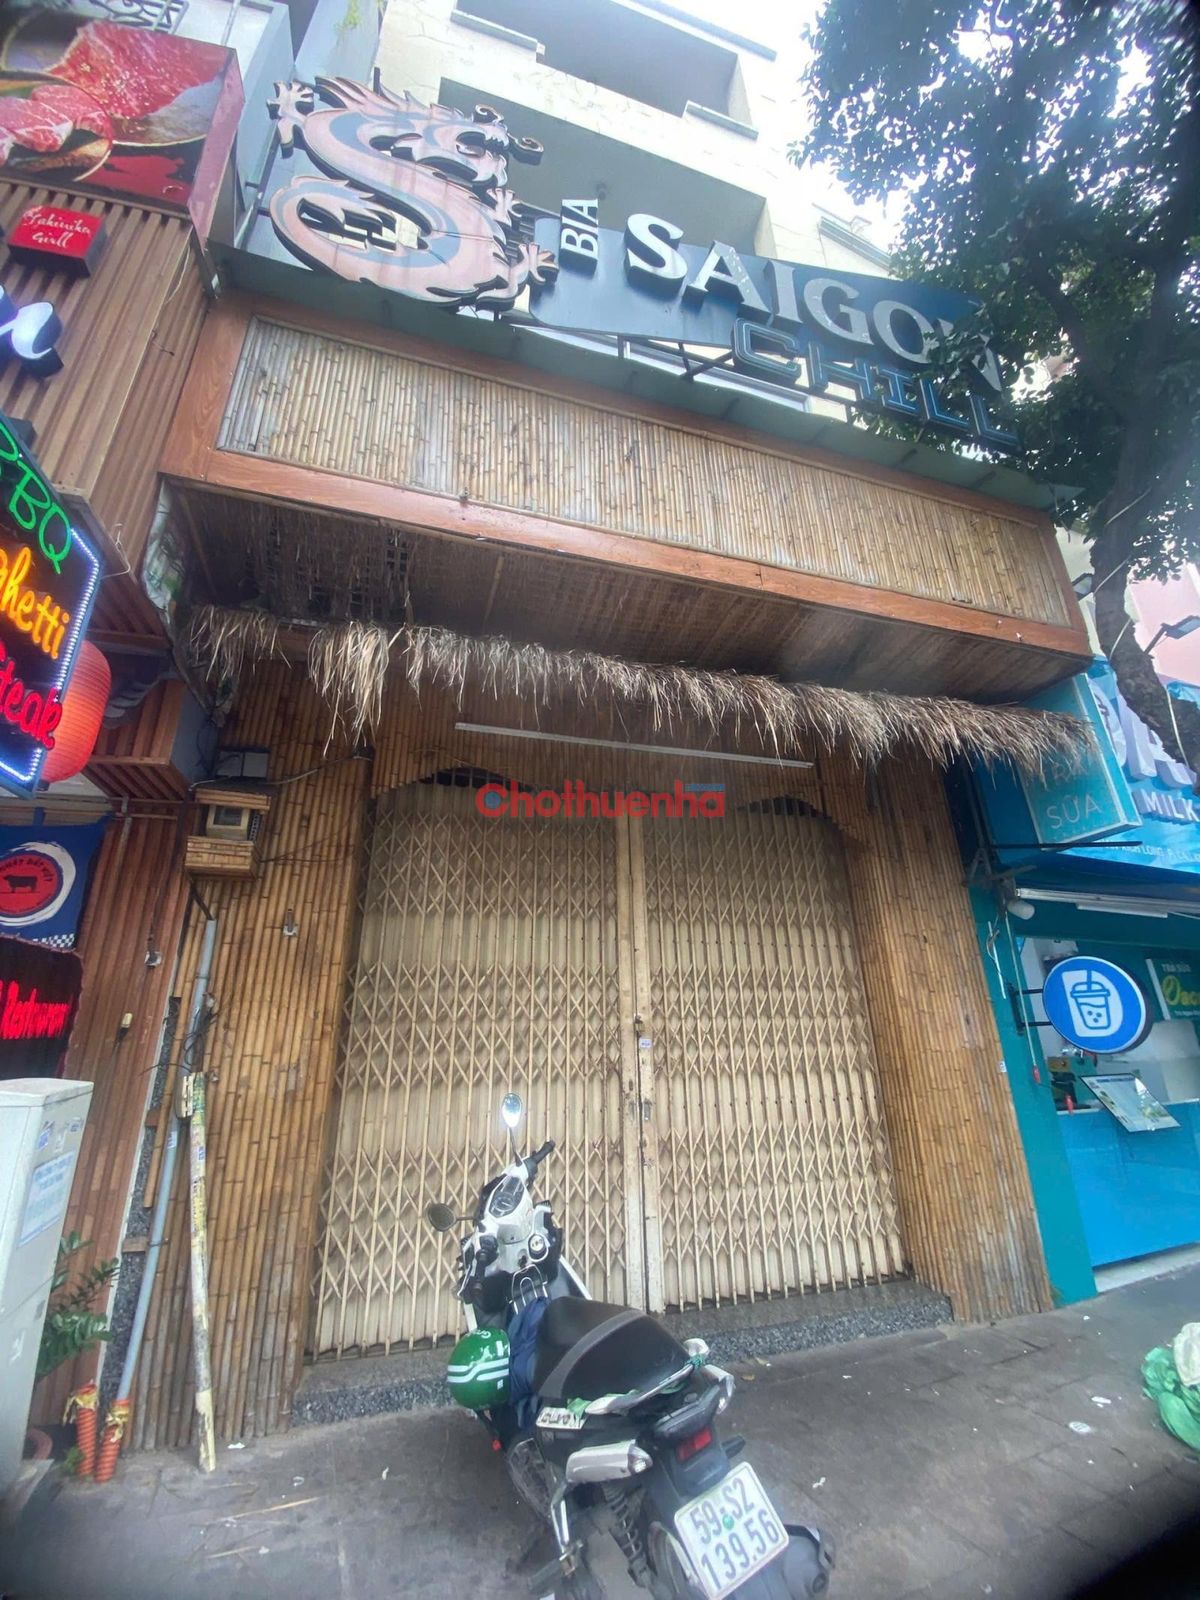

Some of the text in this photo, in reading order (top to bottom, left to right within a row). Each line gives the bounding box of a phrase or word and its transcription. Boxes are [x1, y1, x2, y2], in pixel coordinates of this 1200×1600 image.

[31, 231, 74, 249] Grill
[561, 198, 599, 258] BIA
[731, 317, 1017, 446] CHILL
[0, 640, 62, 750] teak
[1140, 788, 1200, 823] MILK
[701, 1508, 780, 1591] 139.56
